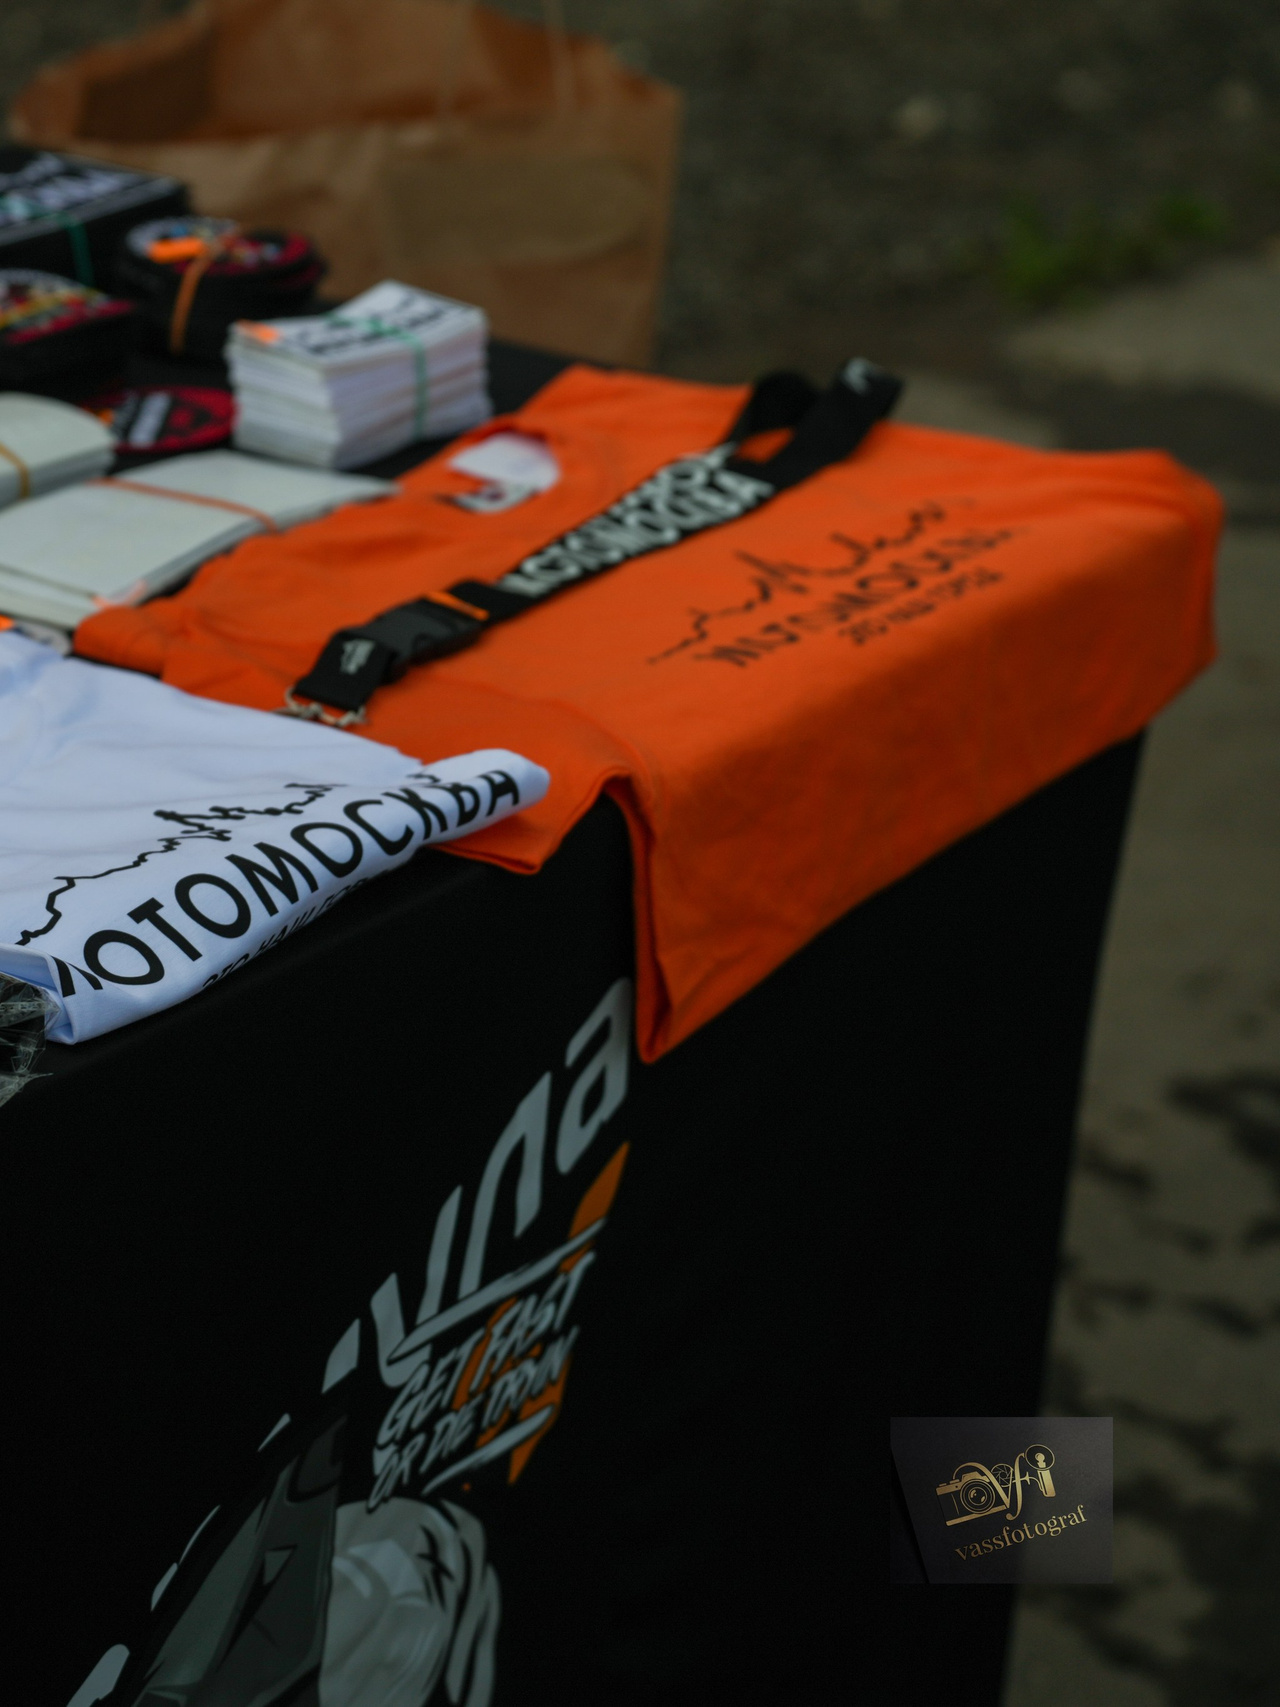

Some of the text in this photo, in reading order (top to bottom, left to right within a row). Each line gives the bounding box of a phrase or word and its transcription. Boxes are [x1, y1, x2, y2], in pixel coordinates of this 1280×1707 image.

[376, 1251, 597, 1451] GET FAST
[367, 1432, 428, 1513] OR
[418, 1390, 486, 1475] DIE
